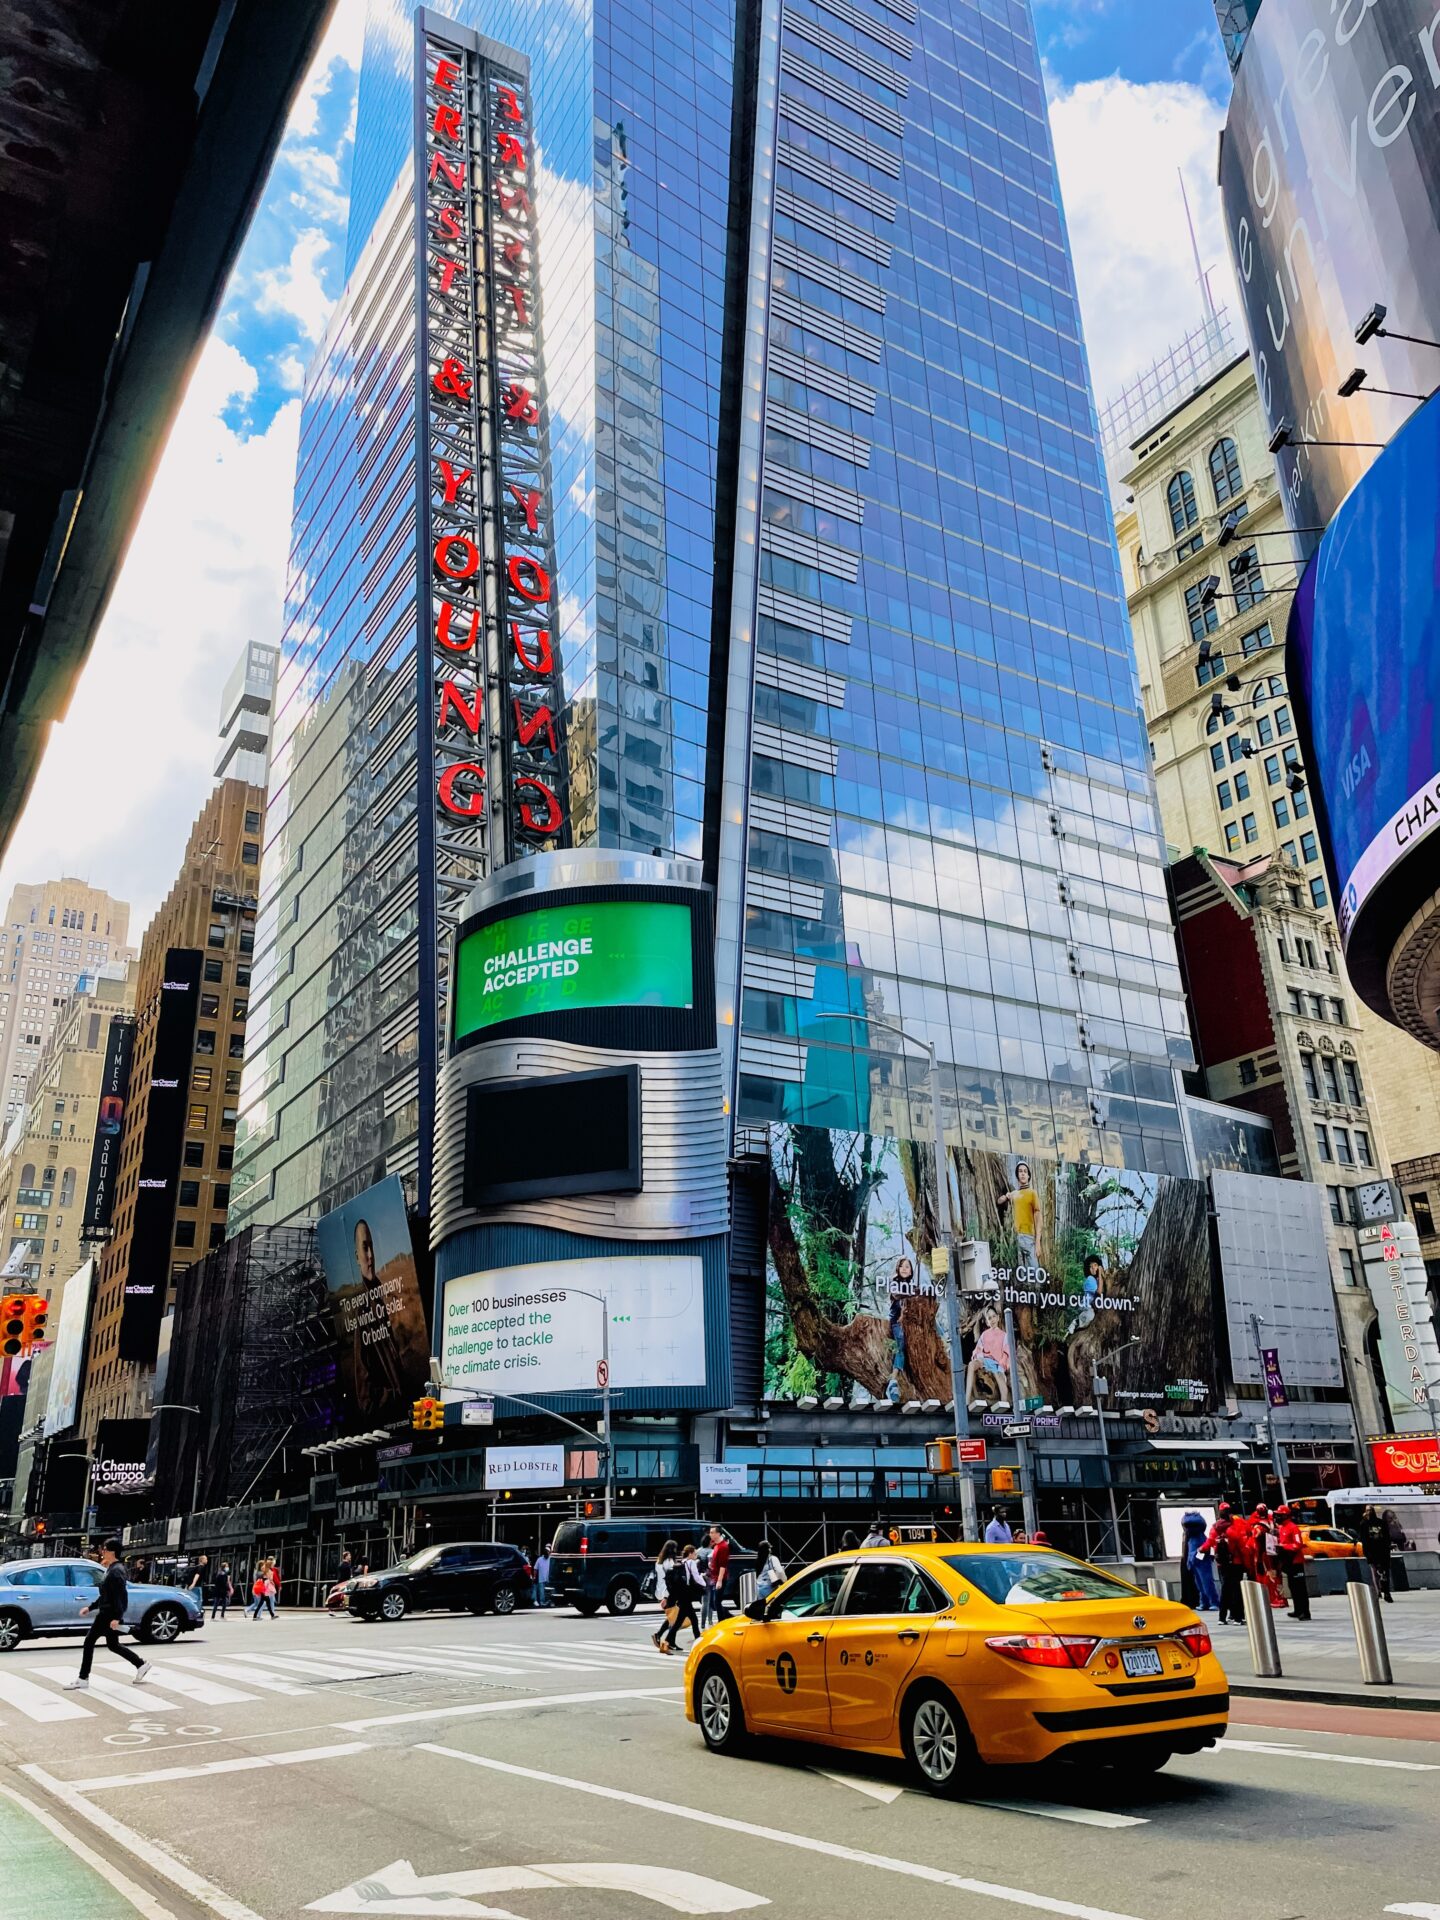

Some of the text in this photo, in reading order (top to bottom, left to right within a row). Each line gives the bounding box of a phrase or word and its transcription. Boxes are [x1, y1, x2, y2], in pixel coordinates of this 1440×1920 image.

[429, 58, 485, 817] ERNST & YOUNG
[1341, 744, 1371, 800] VISA
[484, 938, 593, 975] CHALLENGE
[482, 959, 580, 995] ACCEPTED
[94, 1029, 124, 1220] TIMES SQUARE
[990, 1265, 1050, 1284] ear CEO:
[352, 1291, 368, 1307] every
[370, 1276, 404, 1300] company:
[449, 1290, 567, 1318] Over 100 businesses
[875, 1275, 915, 1296] Plant
[1004, 1287, 1038, 1304] than
[1040, 1292, 1065, 1309] you
[1069, 1293, 1092, 1308] cut
[345, 1297, 406, 1333] Use wind. Or solar.
[448, 1312, 552, 1338] have accepted the
[1380, 1224, 1428, 1404] AMSTERDAM
[362, 1331, 371, 1346] Or
[447, 1332, 554, 1357] challenge to tackle
[446, 1354, 541, 1377] the climate crisis.
[1114, 1390, 1164, 1399] challenge accepted
[1036, 1417, 1059, 1426] PRIME
[488, 1461, 559, 1476] RED LOBSTER
[724, 1466, 742, 1474] Square
[908, 1528, 926, 1540] 1D94
[780, 1660, 792, 1689] T
